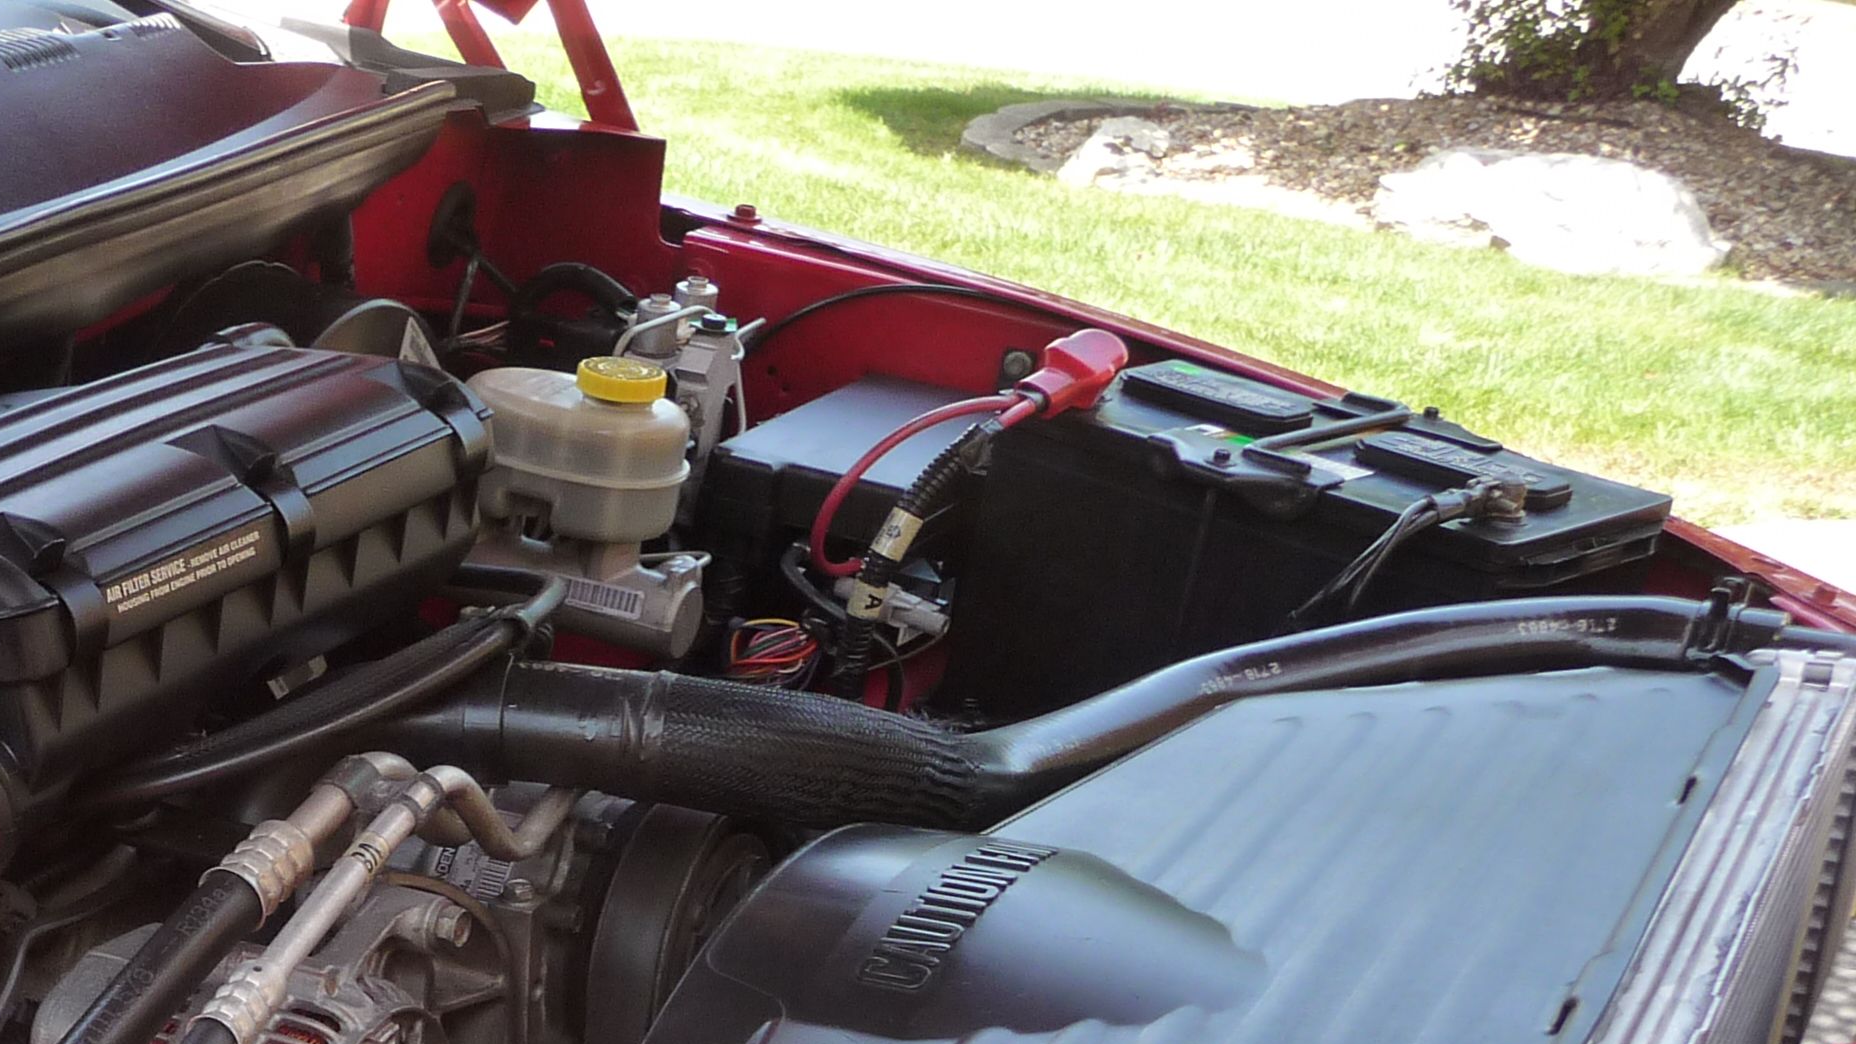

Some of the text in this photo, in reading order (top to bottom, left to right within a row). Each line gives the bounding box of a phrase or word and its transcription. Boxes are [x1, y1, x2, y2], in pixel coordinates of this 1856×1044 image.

[106, 584, 123, 603] AIR
[121, 571, 152, 598] FILTER
[150, 557, 187, 585] SERVICE
[117, 592, 150, 613] HOUSING
[857, 863, 1019, 992] CAUTION
